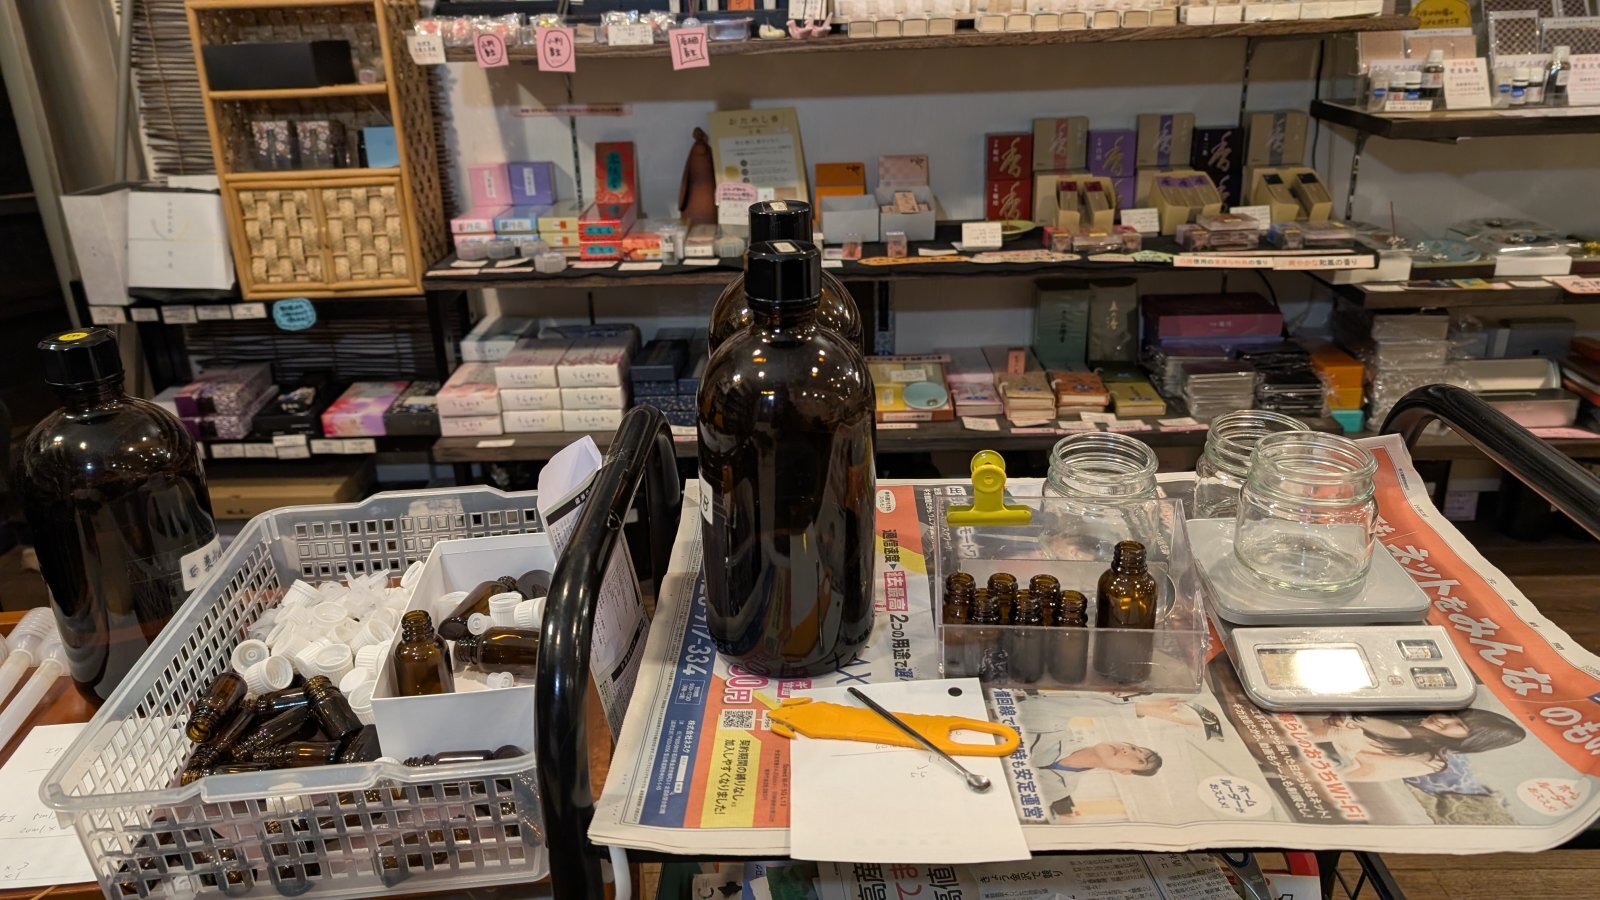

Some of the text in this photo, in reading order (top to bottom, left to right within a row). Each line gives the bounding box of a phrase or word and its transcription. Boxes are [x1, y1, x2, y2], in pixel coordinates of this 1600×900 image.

[882, 529, 900, 563] 通信速度
[889, 613, 914, 681] 2つの用途で選
[713, 738, 736, 815] 加入しやすくなりました!
[732, 739, 751, 801] 契約期間の縛りなし
[993, 687, 1044, 819] 備回線で時も安定運営
[1237, 784, 1258, 807] ホーム
